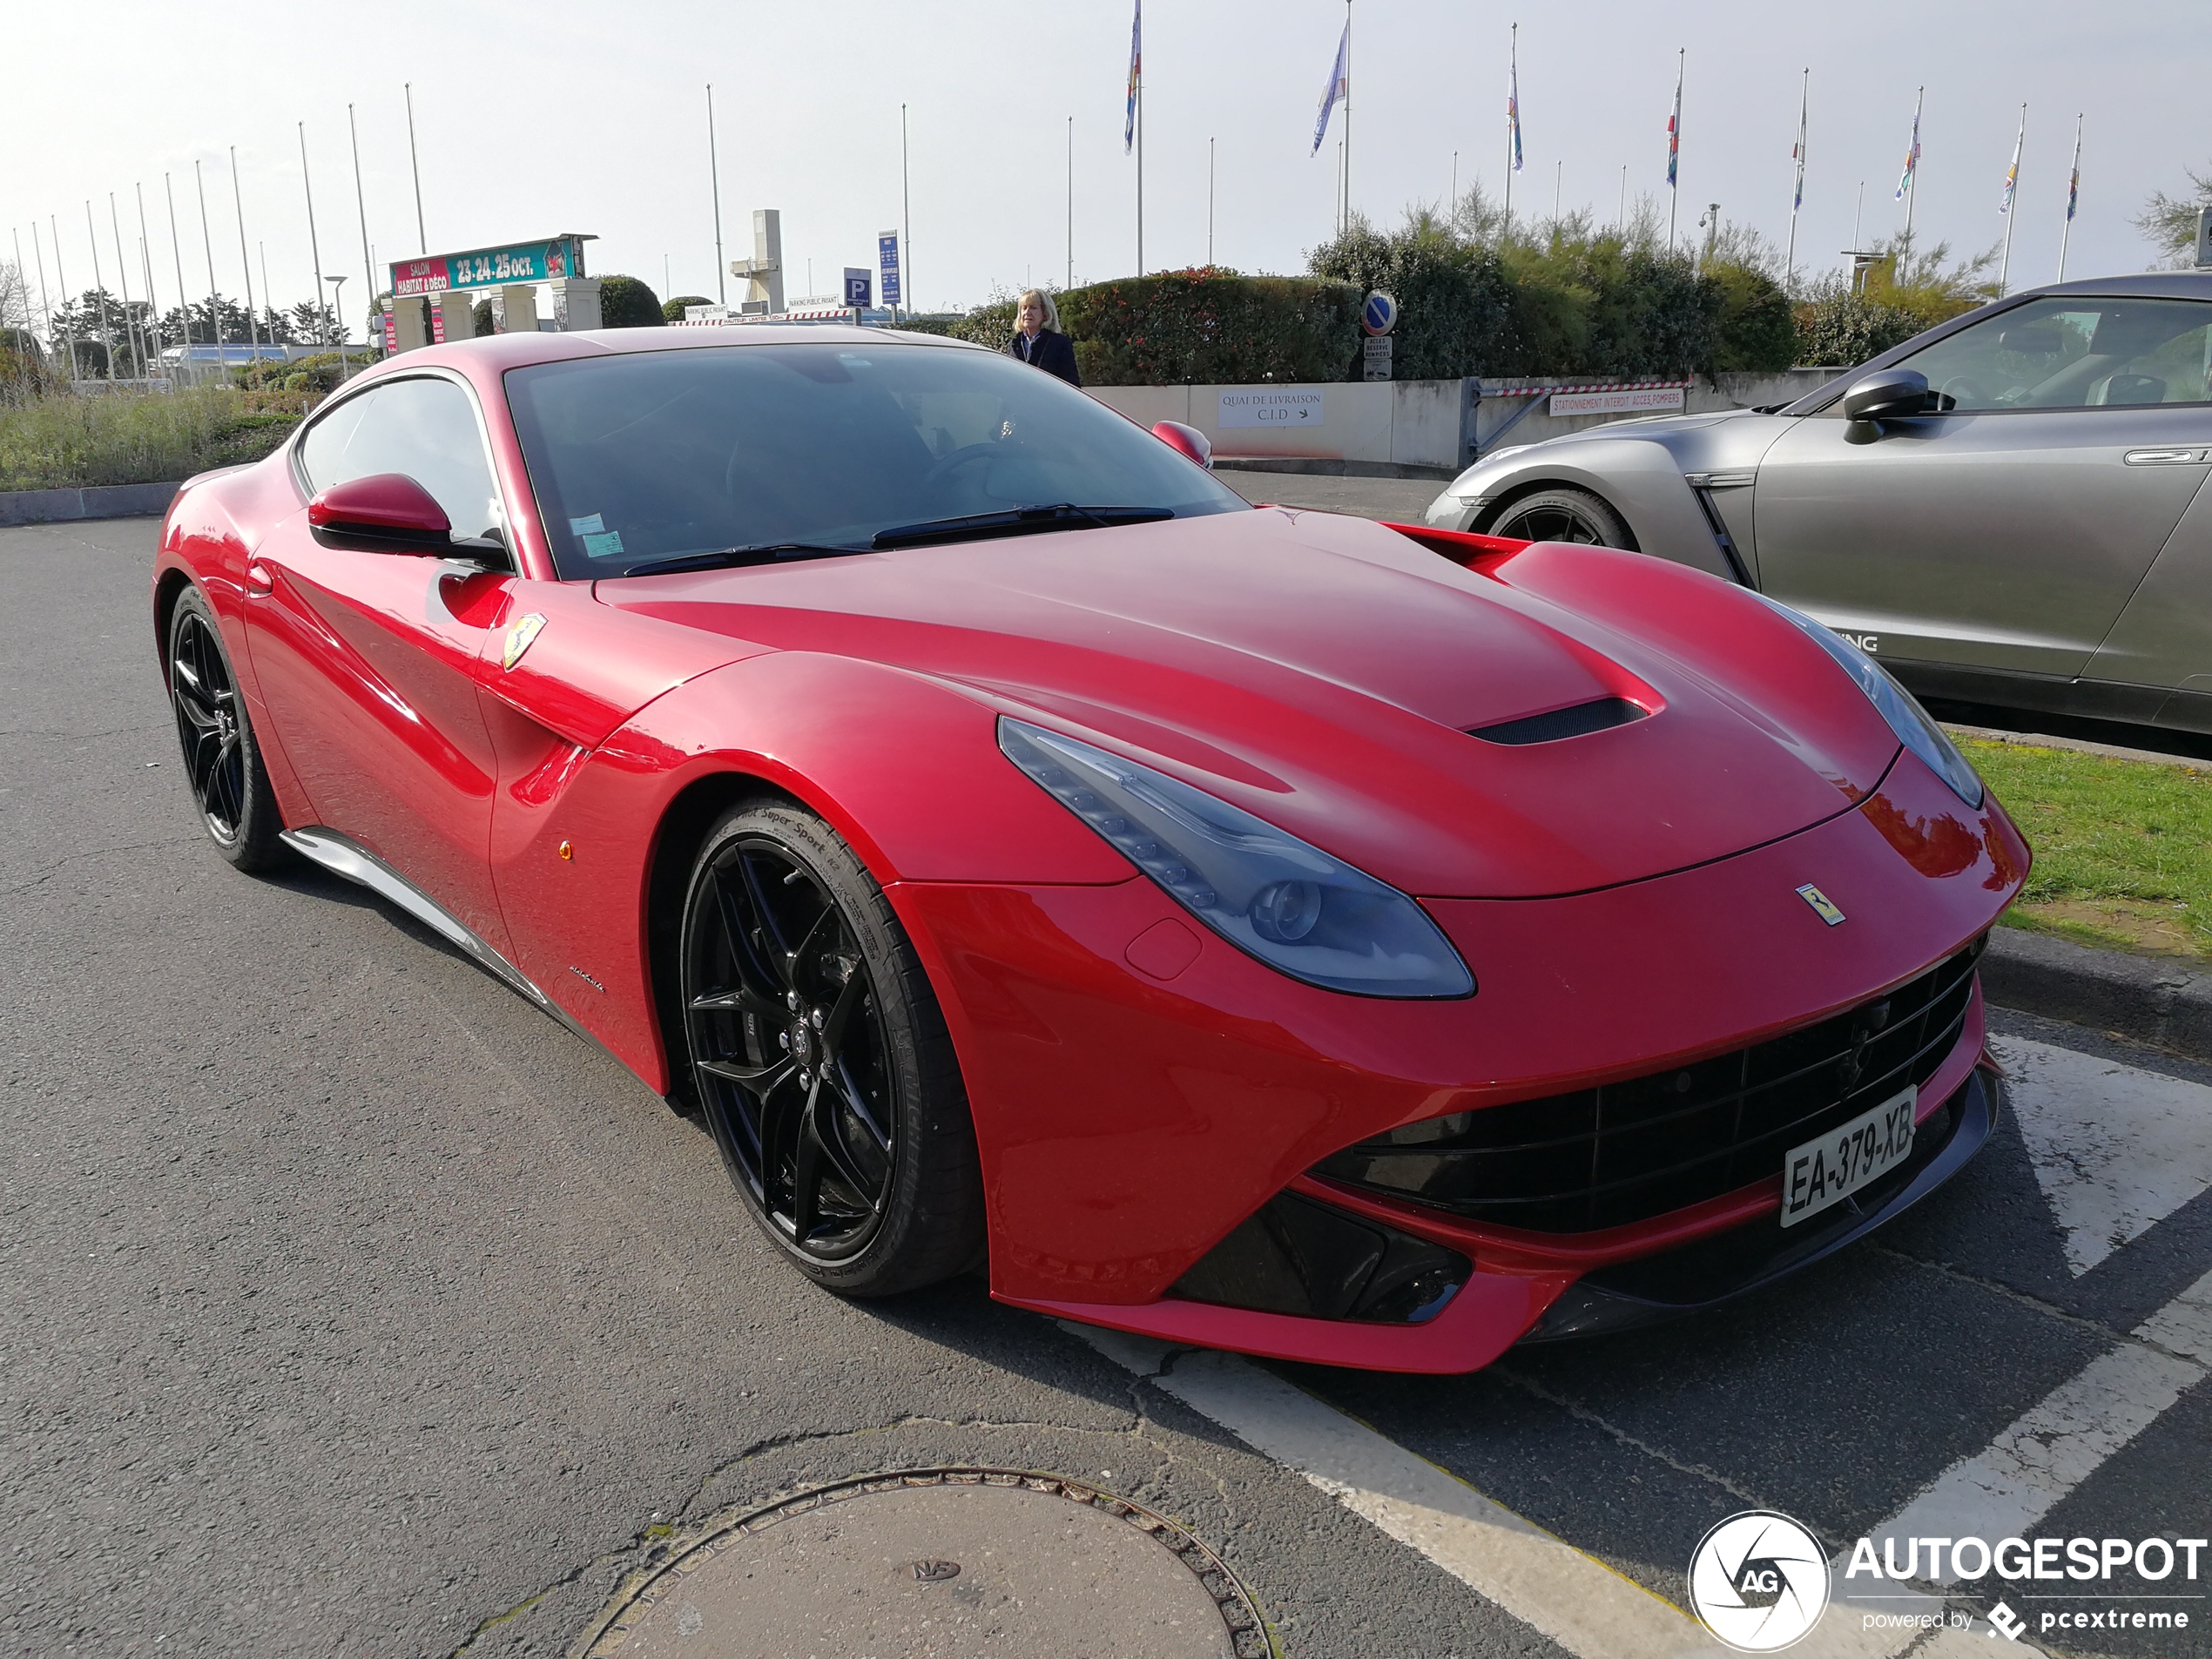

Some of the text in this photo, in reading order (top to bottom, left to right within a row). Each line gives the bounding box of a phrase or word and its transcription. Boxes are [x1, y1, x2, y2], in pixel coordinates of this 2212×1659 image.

[409, 261, 430, 277] SALON
[397, 279, 423, 295] HABITAT
[429, 273, 448, 290] DÉCO
[851, 280, 866, 298] P
[789, 299, 806, 307] PARKING
[807, 297, 821, 306] PUBLIC
[1223, 395, 1320, 407] QUAI DE LIVRAISON
[1554, 398, 1602, 411] STATIONNEMENT
[1603, 396, 1629, 408] INTERDIT
[1258, 408, 1288, 421] C.I.D
[761, 808, 792, 826] Super
[793, 822, 826, 855] Sport
[1789, 1100, 1912, 1215] EA-379-XB
[912, 1561, 950, 1579] NF
